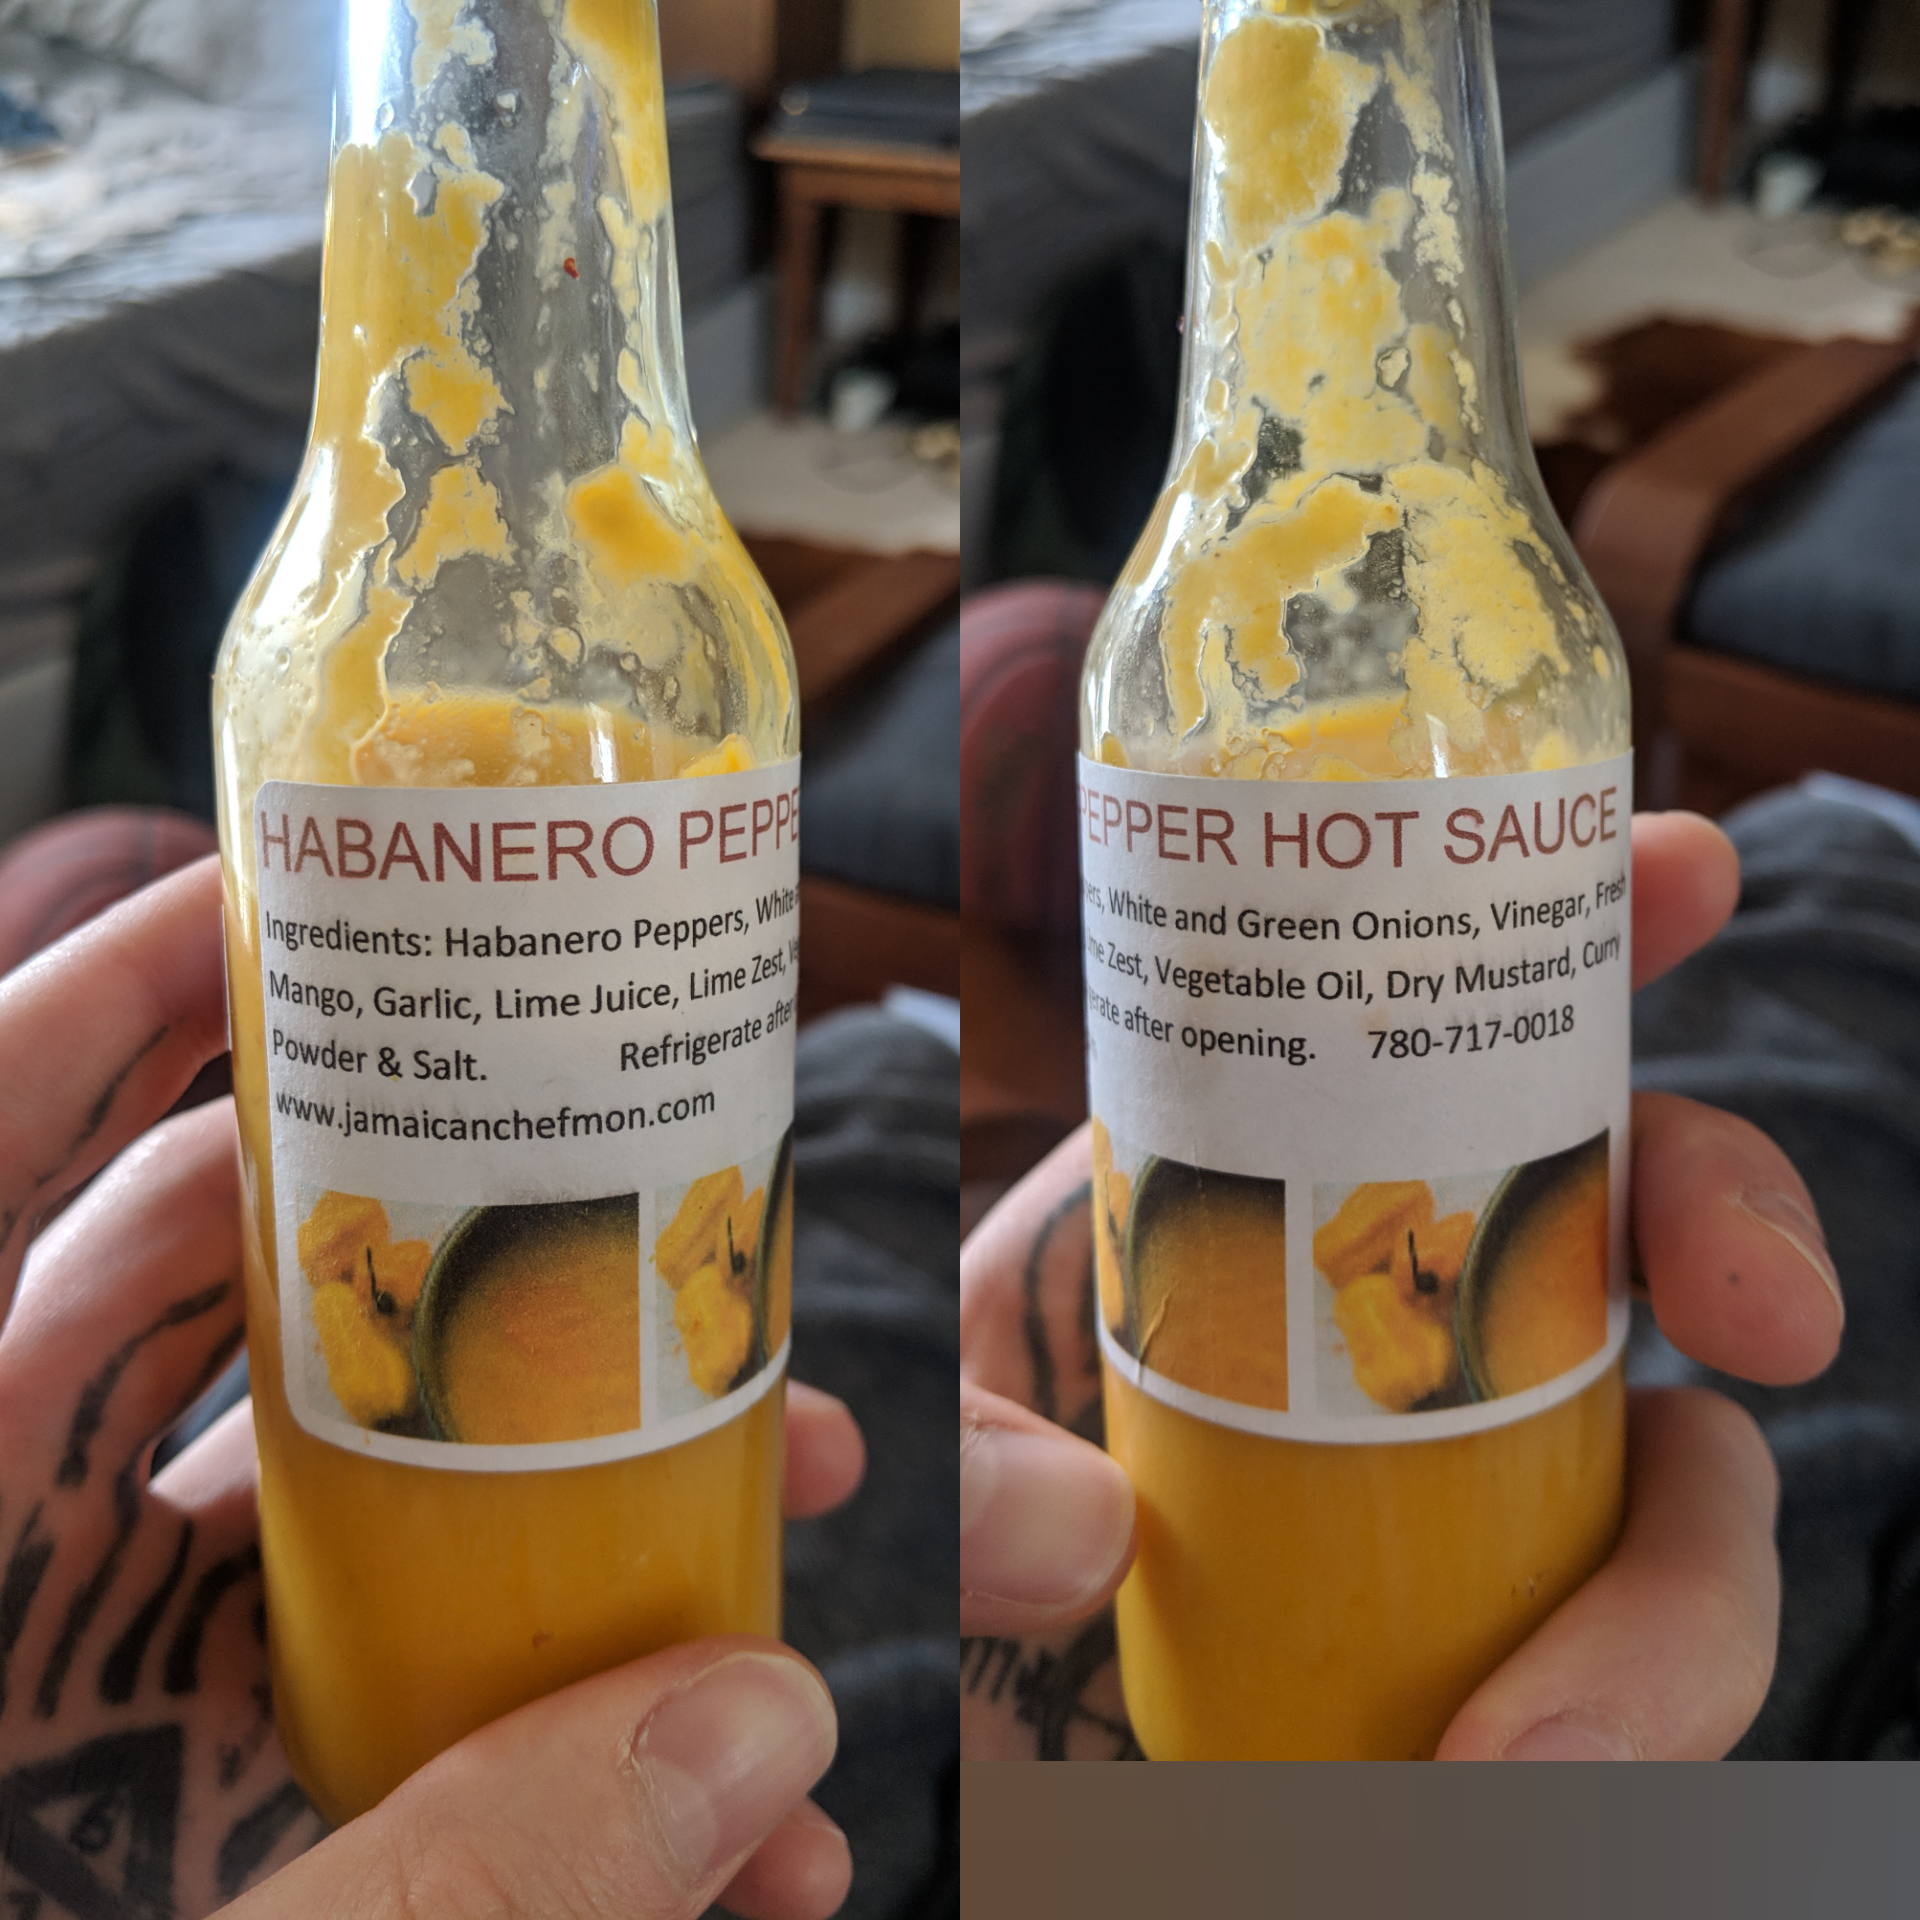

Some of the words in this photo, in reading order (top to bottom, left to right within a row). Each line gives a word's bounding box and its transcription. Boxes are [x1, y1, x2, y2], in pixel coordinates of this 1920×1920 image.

[260, 811, 655, 882] HABANERO
[1264, 811, 1420, 869] HOT
[1444, 786, 1617, 864] SAUCE
[266, 911, 432, 956] Ingredients:
[446, 925, 622, 957] Habanero
[634, 908, 749, 950] Peppers,
[756, 888, 794, 924] White
[1109, 886, 1167, 927] White
[1175, 906, 1226, 935] and
[1238, 909, 1340, 940] Green
[1352, 909, 1480, 940] Onions,
[1491, 893, 1591, 931] Vinegar,
[1596, 873, 1626, 910] Fresh
[269, 970, 363, 1019] Mango,
[373, 986, 481, 1025] Garlic,
[496, 989, 580, 1019] Lime
[589, 980, 679, 1014] Juice,
[690, 966, 746, 1001] Lime
[752, 947, 786, 984] Zest,
[1108, 941, 1149, 985] Zest,
[1155, 956, 1306, 1000] Vegetable
[1317, 970, 1373, 1005] Oil,
[1388, 970, 1444, 1003] Dry
[1456, 946, 1576, 994] Mustard,
[1583, 933, 1621, 968] Curry
[273, 1028, 368, 1073] Powder
[378, 1047, 403, 1078] &
[413, 1049, 488, 1081] Salt.
[620, 1019, 762, 1072] Refrigerate
[766, 999, 793, 1034] after
[1125, 1006, 1173, 1042] after
[1181, 1026, 1316, 1066] opening.
[1368, 1004, 1574, 1059] 780-717-0018
[276, 1091, 716, 1141] www.jamaicanchefmon.com
